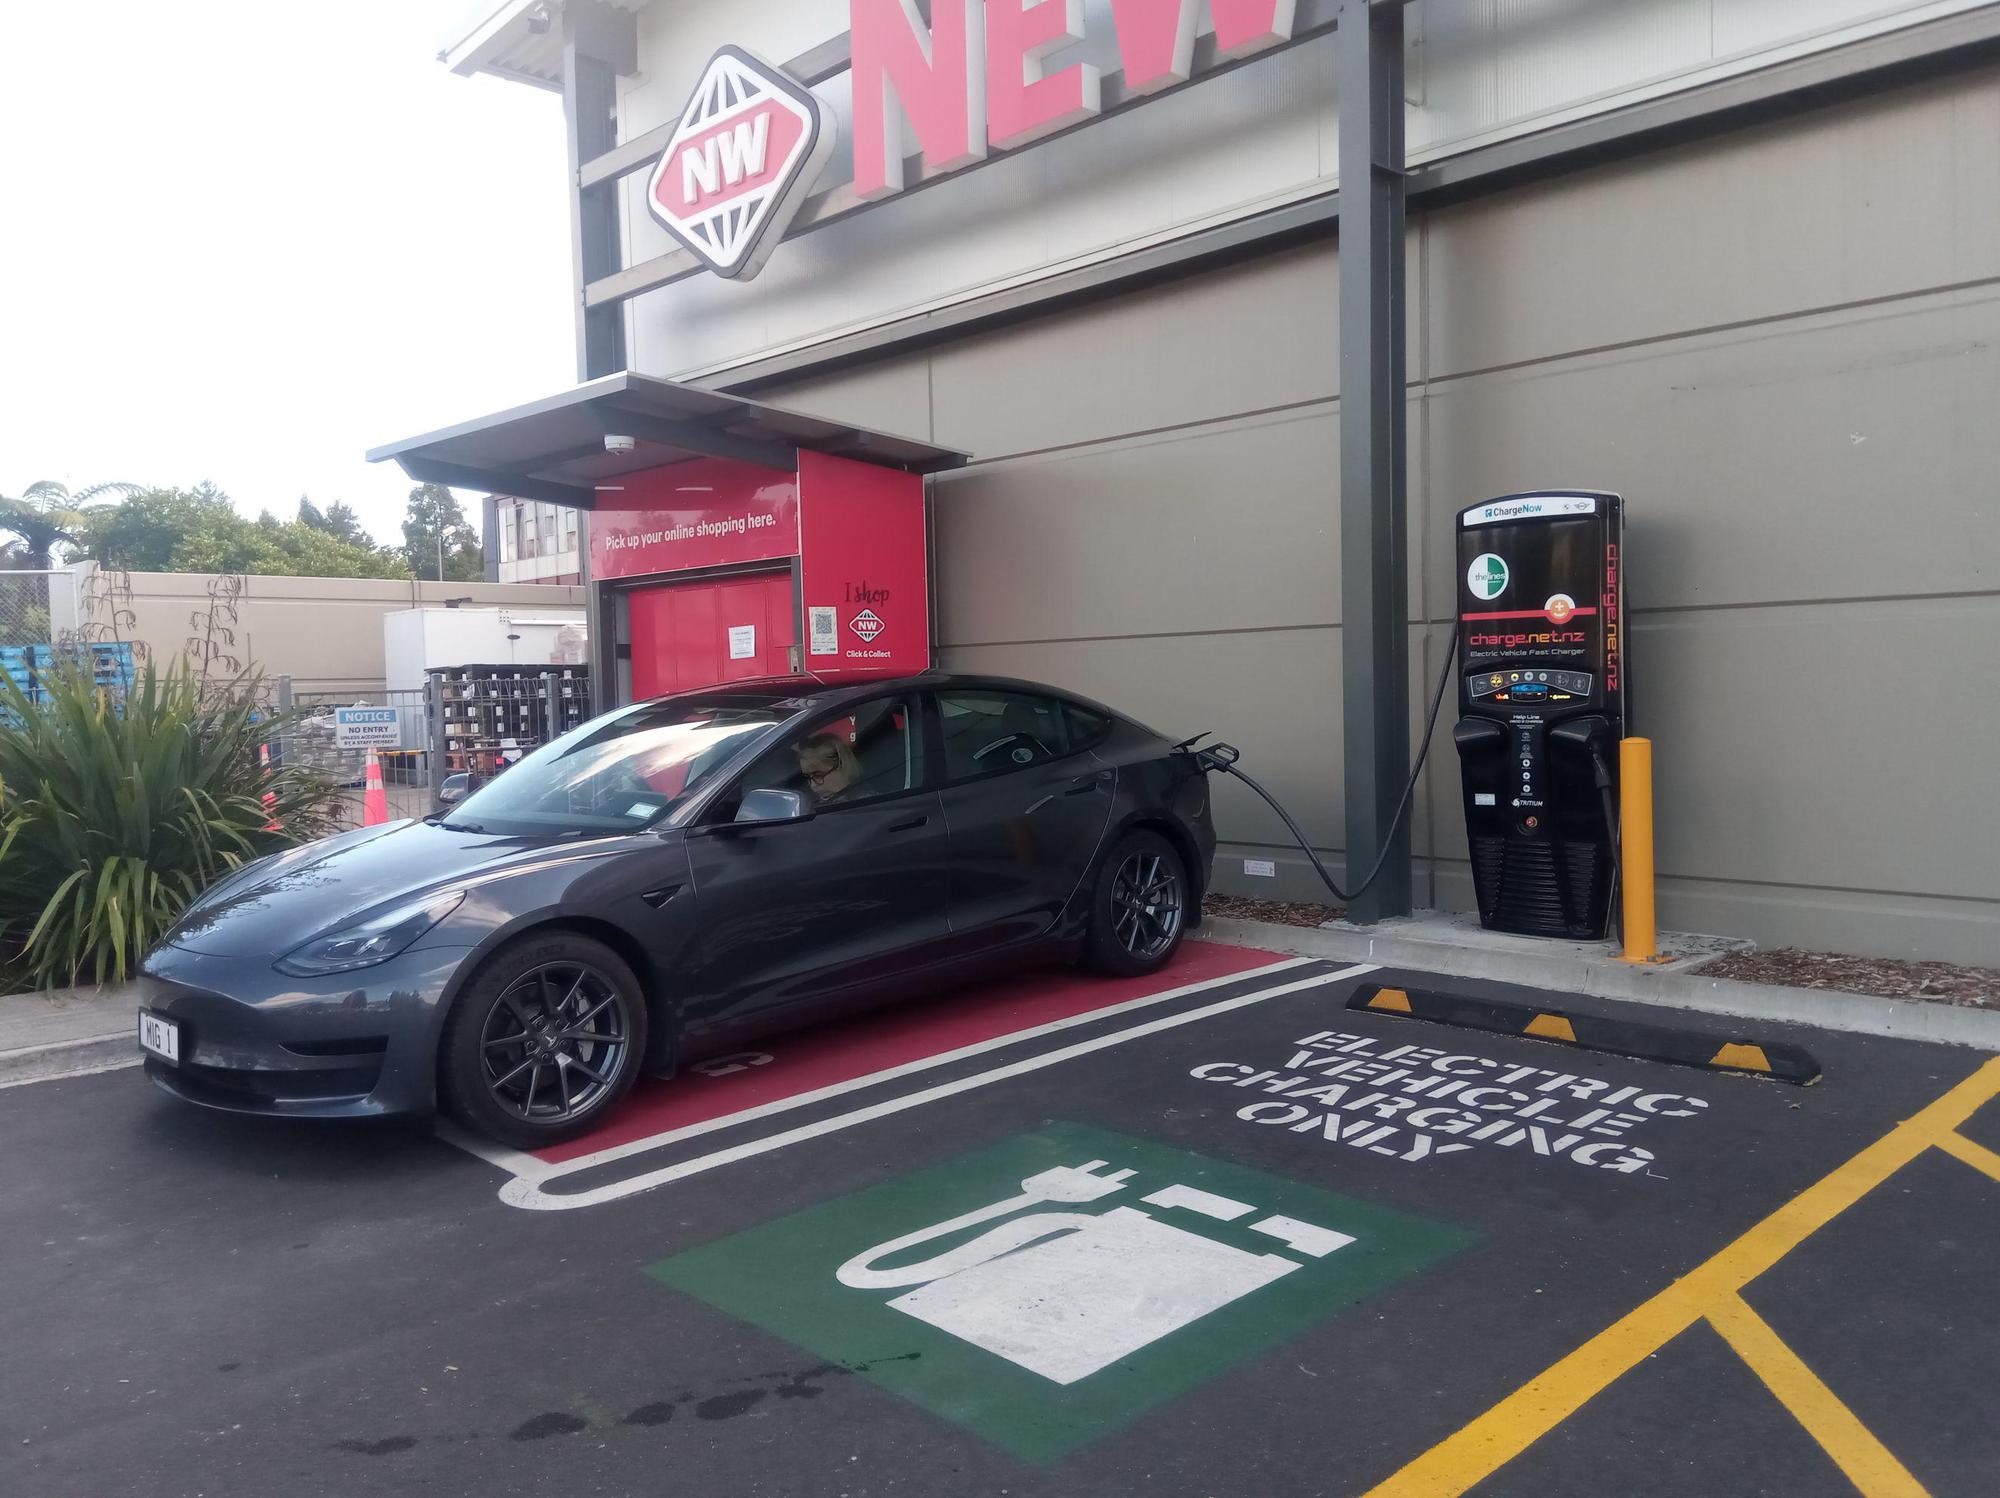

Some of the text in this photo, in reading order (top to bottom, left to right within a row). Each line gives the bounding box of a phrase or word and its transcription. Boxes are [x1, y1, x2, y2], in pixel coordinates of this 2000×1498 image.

[681, 112, 770, 204] NW
[1493, 503, 1543, 517] ChargeNow
[606, 512, 776, 550] Pick up your online shopping here.
[855, 580, 890, 607] shop
[858, 620, 877, 631] NW
[1602, 543, 1619, 692] charge.net.nz
[1470, 630, 1585, 647] charge.net.nz
[1551, 648, 1585, 656] Charger
[846, 650, 862, 658] Click
[868, 650, 891, 658] Collect
[345, 712, 390, 721] NOTICE
[167, 1029, 171, 1053] 1
[1293, 1031, 1709, 1117] ELECTRIC
[1284, 1050, 1649, 1136] VEHICLE
[1190, 1062, 1655, 1173] CHARGING
[1236, 1102, 1475, 1162] ONLY
